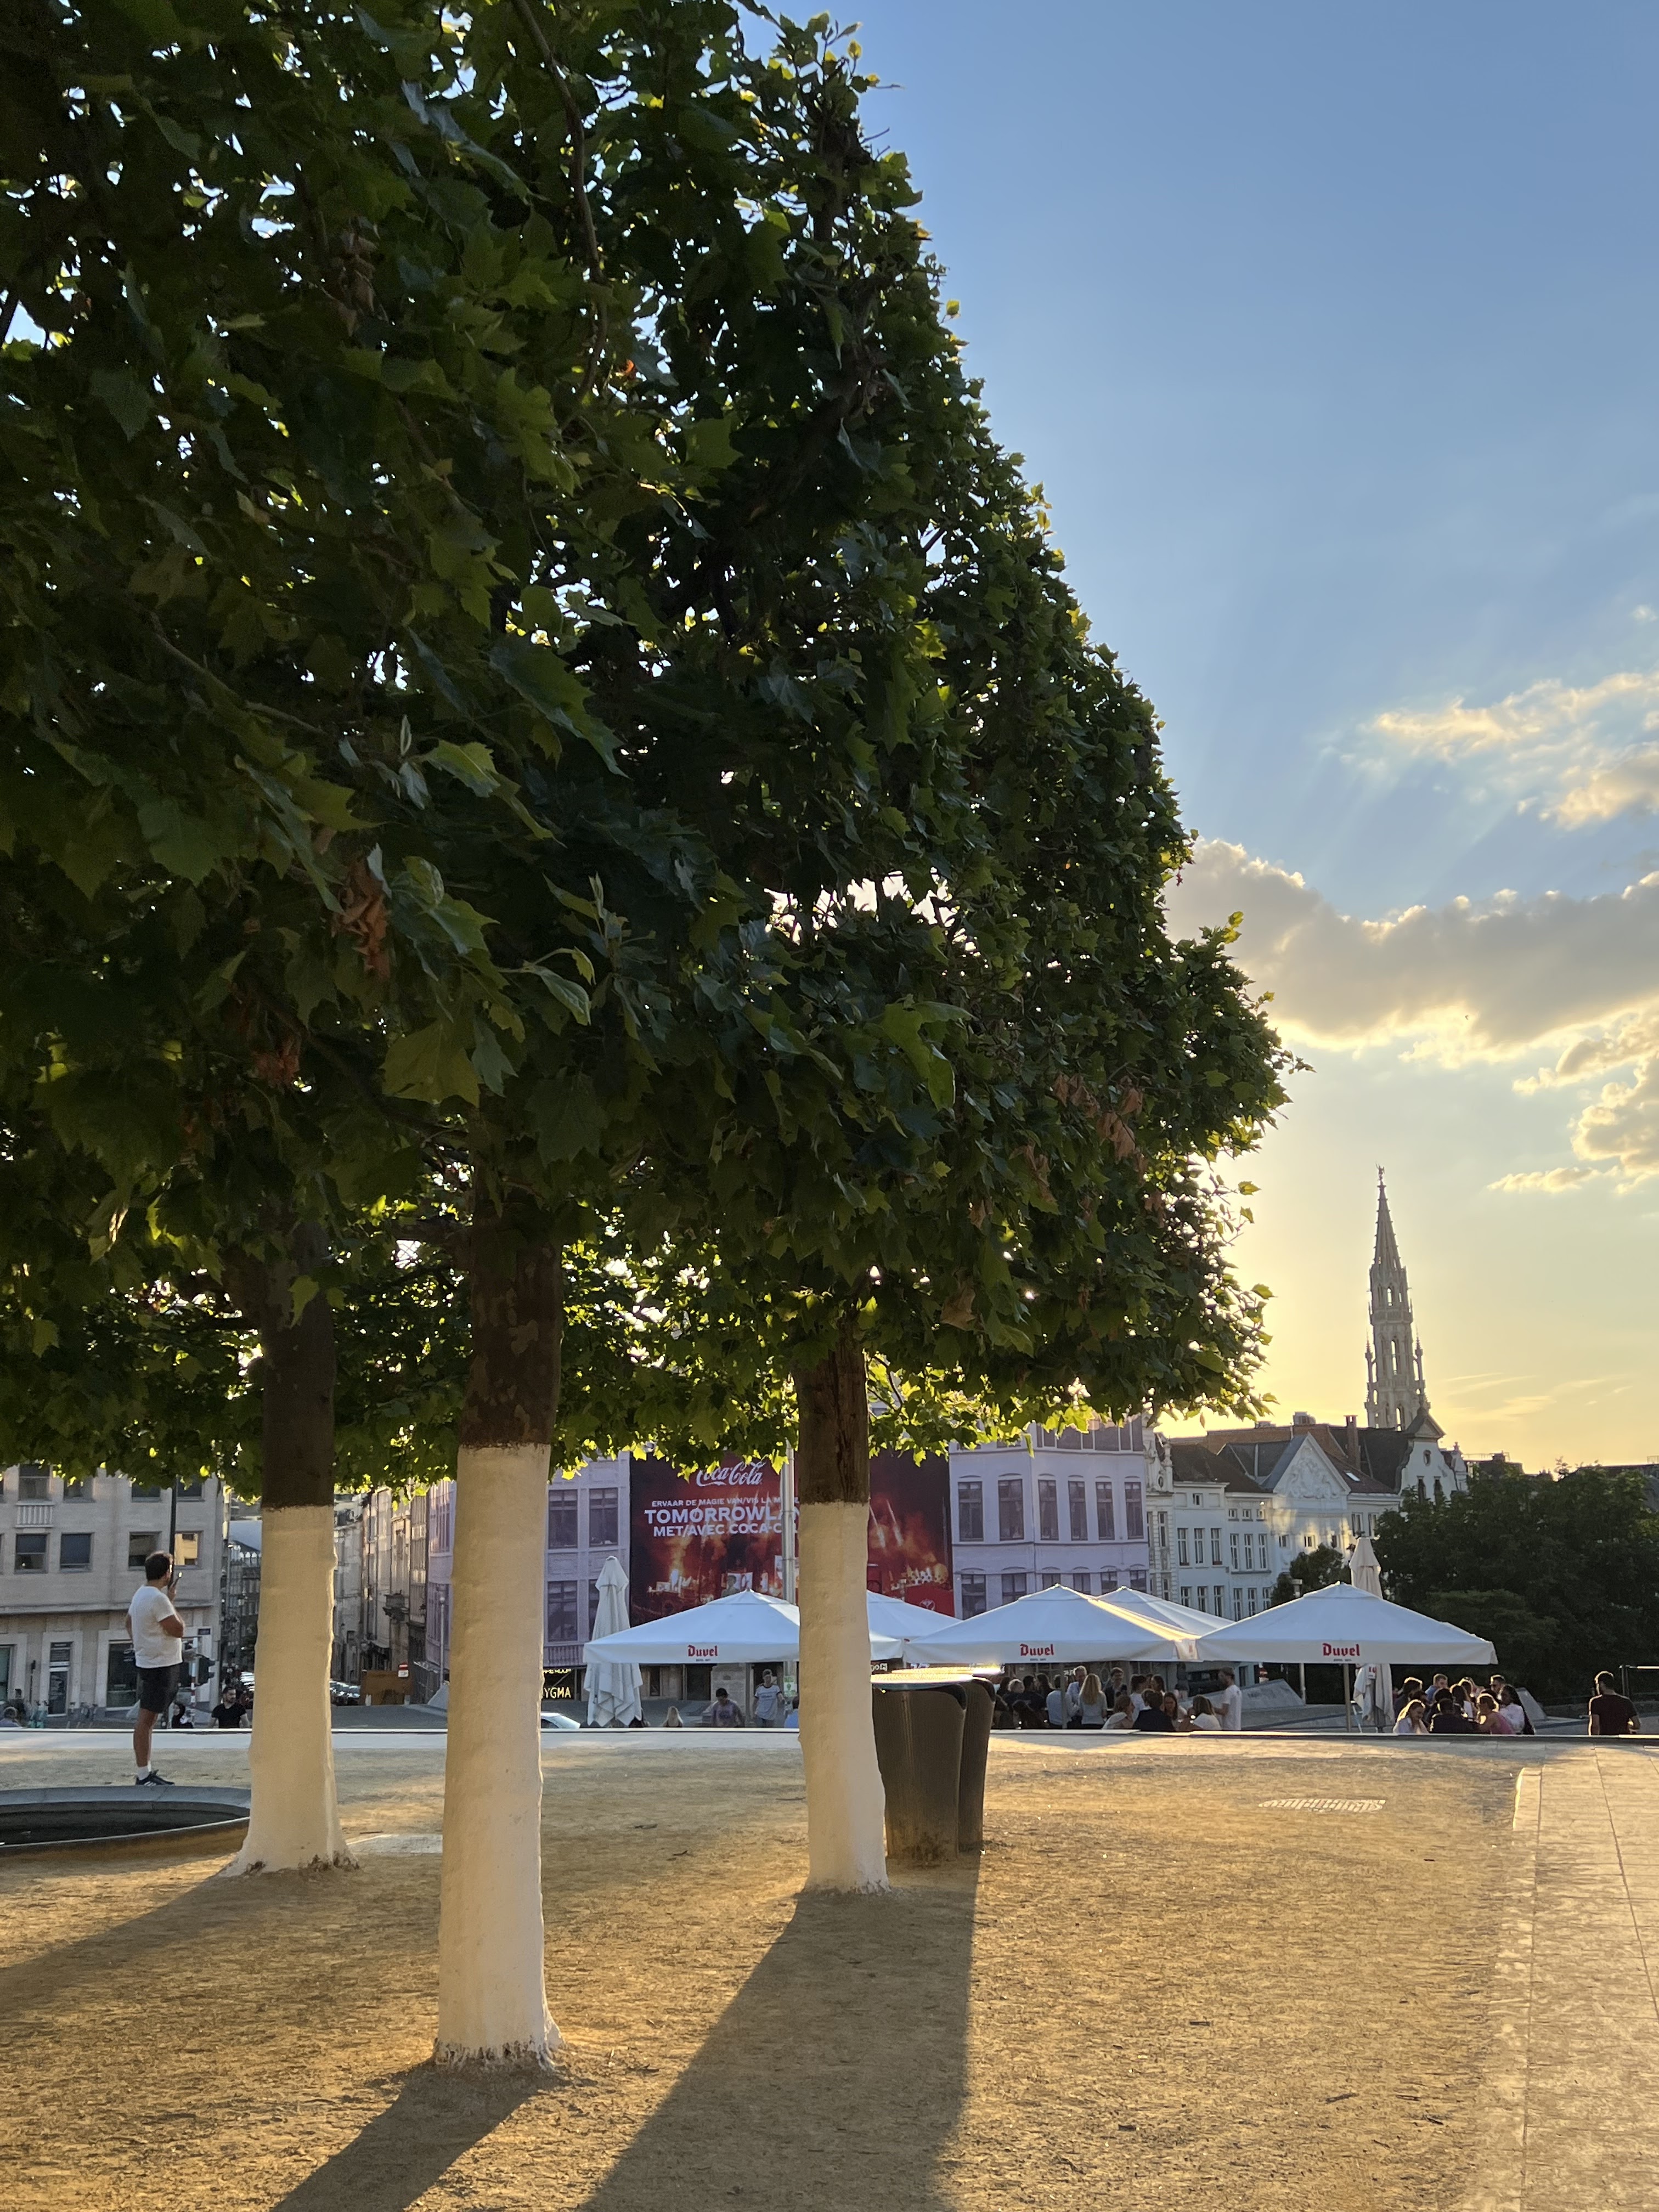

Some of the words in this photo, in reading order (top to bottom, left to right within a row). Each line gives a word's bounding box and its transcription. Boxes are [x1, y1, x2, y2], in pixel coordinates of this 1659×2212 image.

[644, 1505, 800, 1524] TOMORROWLN
[653, 1524, 724, 1537] MET/AVEC
[687, 1645, 718, 1656] Duvel
[1020, 1644, 1054, 1656] Duvel
[1322, 1643, 1360, 1656] Duvel
